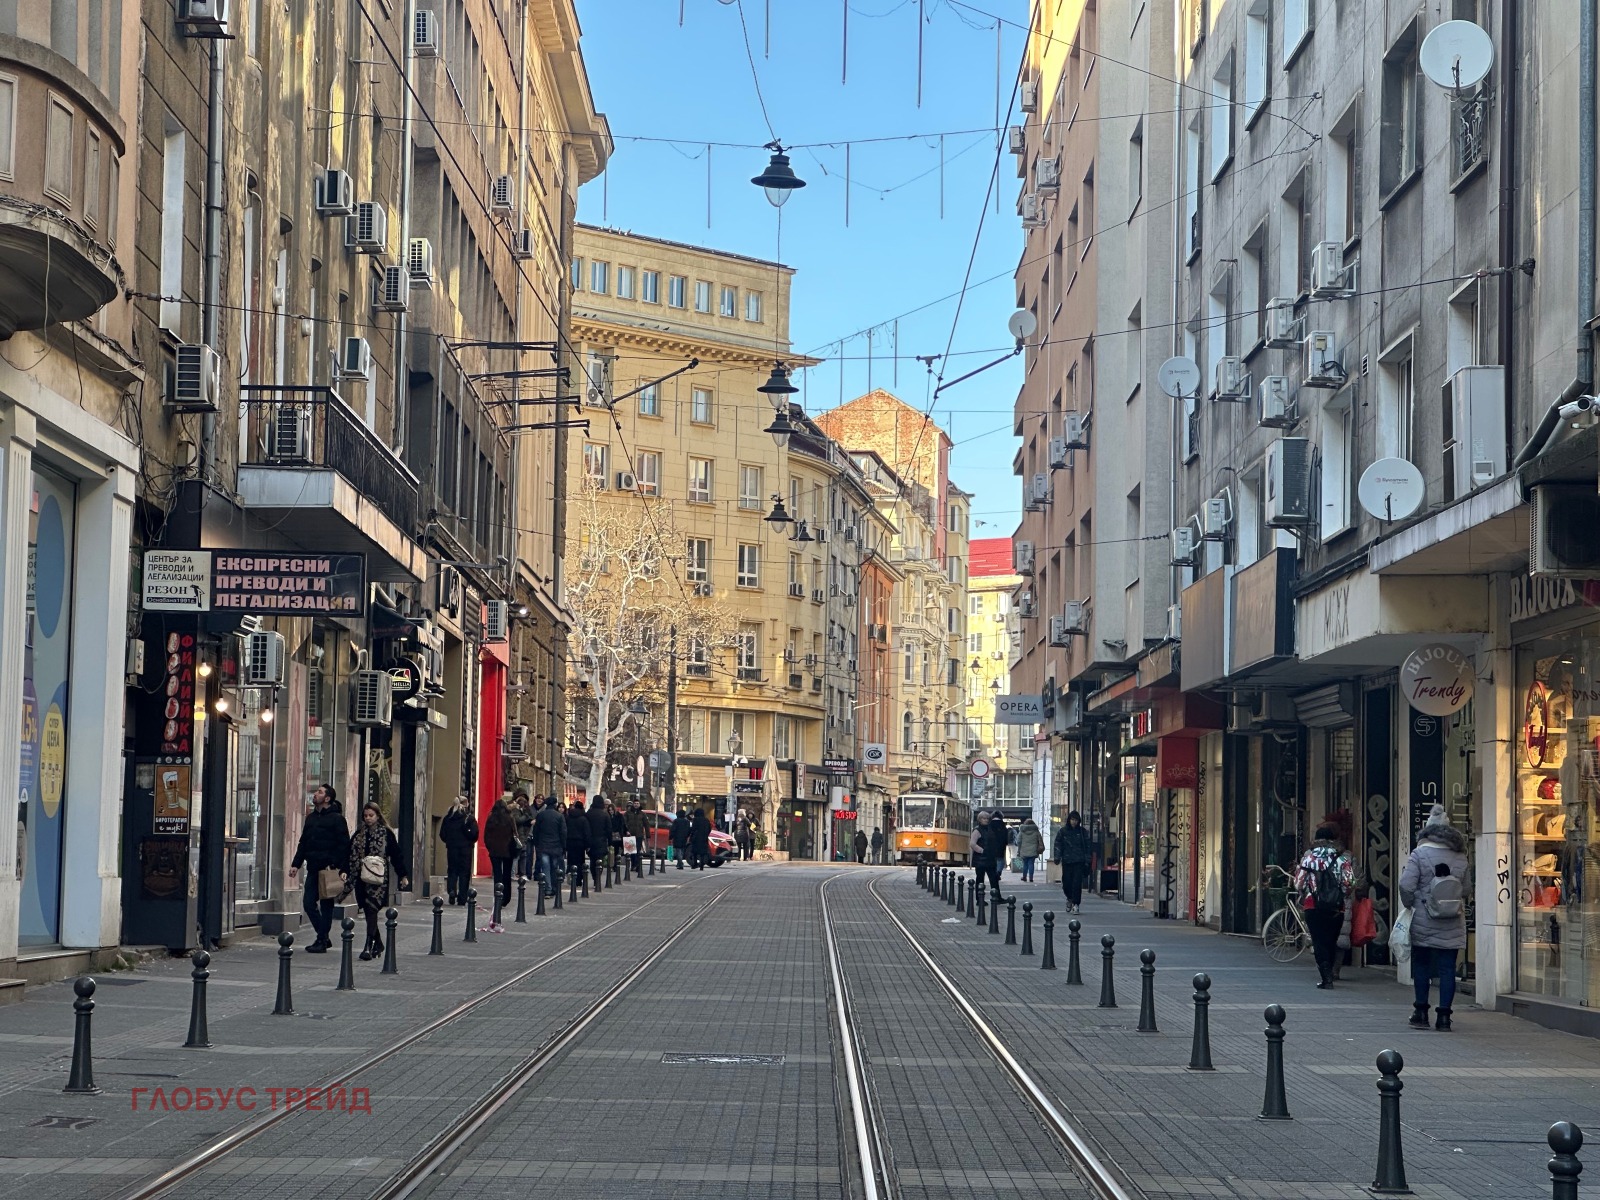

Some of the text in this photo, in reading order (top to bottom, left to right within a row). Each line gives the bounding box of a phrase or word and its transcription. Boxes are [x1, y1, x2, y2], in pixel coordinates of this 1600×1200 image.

[148, 555, 179, 563] ЦЕНТЪР
[216, 557, 330, 573] ЕКСПРЕСНИ
[148, 564, 186, 572] ПРЕВОДИ
[147, 573, 204, 582] ЛЕГАЛИЗАЦИИ
[215, 575, 326, 592] ПРЕВОДИ И
[147, 585, 187, 594] РЕЗОН
[215, 593, 356, 611] ЛЕГАЛИЗАЦИЯ
[1407, 647, 1469, 675] BIJOUX
[178, 635, 194, 752] ФИЛИЙКА
[1412, 677, 1466, 706] Trendy
[1000, 702, 1039, 712] OPERA
[46, 731, 60, 748] ЦЕНА
[606, 764, 635, 783] FC
[814, 779, 829, 796] KFC
[834, 810, 858, 820] NON STOP
